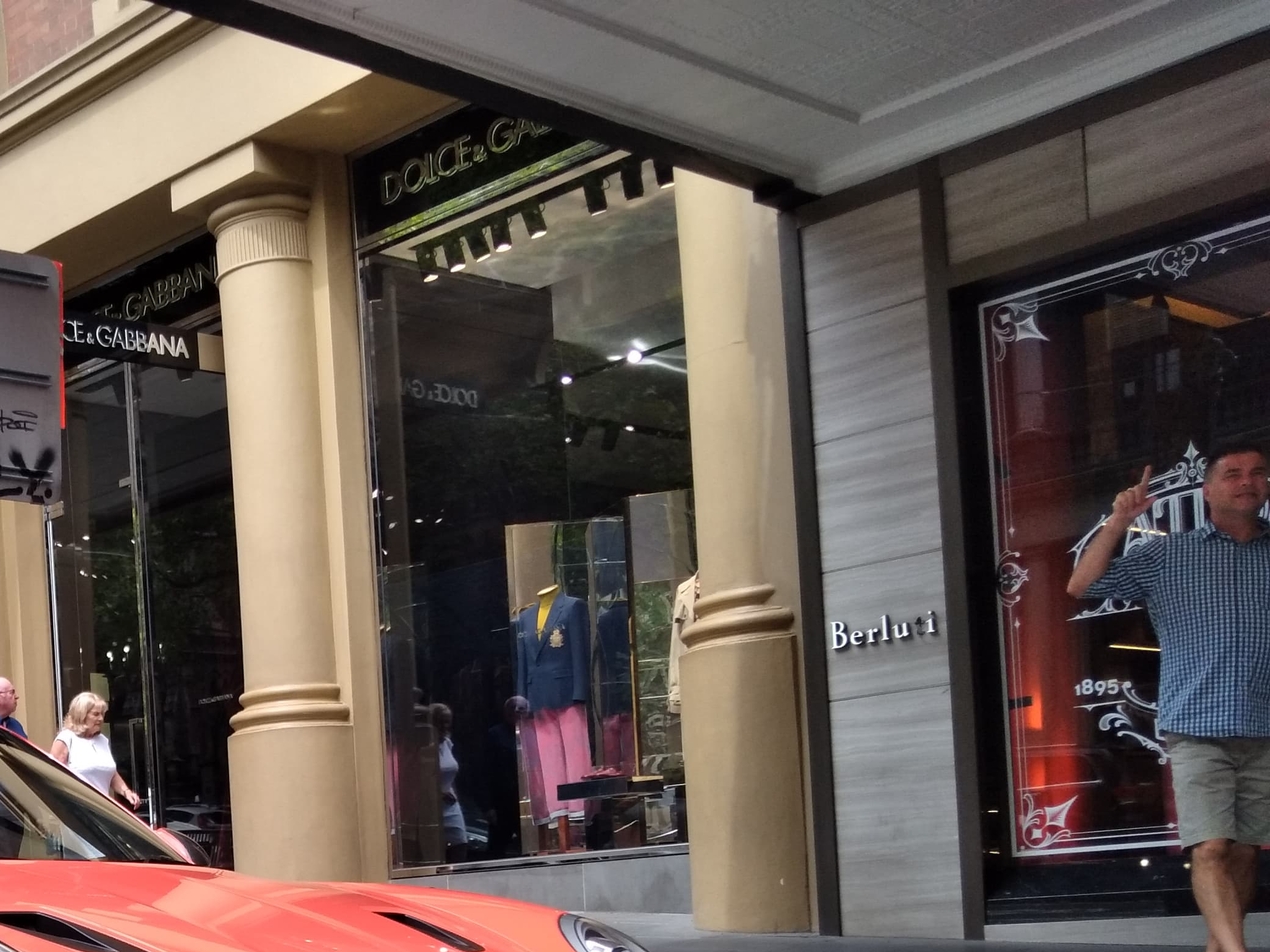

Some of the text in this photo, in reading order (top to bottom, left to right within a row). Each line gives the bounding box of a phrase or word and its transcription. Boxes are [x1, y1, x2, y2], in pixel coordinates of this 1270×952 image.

[383, 134, 473, 205] DOLCE
[473, 144, 487, 163] &
[96, 325, 190, 359] GABBANA
[830, 610, 937, 650] Berluti
[1074, 678, 1120, 696] 1895
